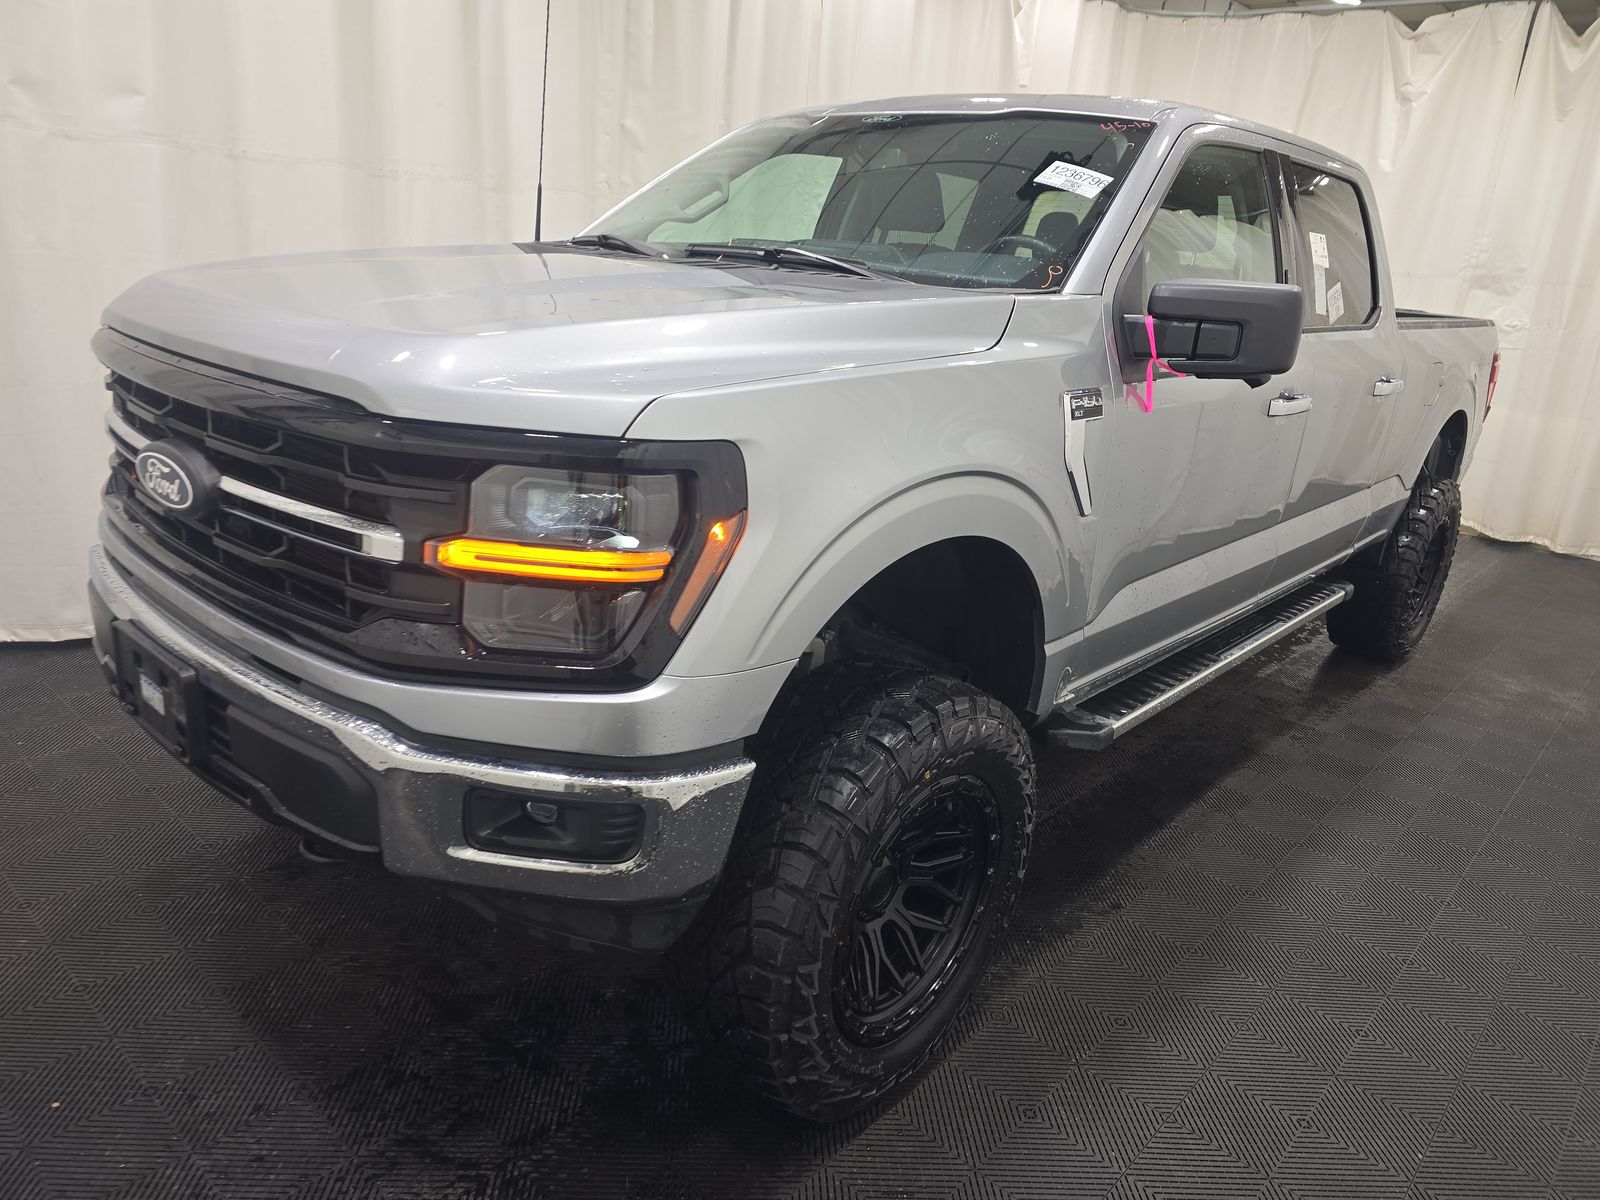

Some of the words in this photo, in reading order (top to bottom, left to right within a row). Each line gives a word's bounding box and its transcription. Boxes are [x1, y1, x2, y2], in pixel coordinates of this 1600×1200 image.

[1100, 121, 1151, 132] 45-10
[1051, 165, 1110, 188] 1236796
[1075, 410, 1083, 418] XLT
[145, 458, 181, 501] Ford
